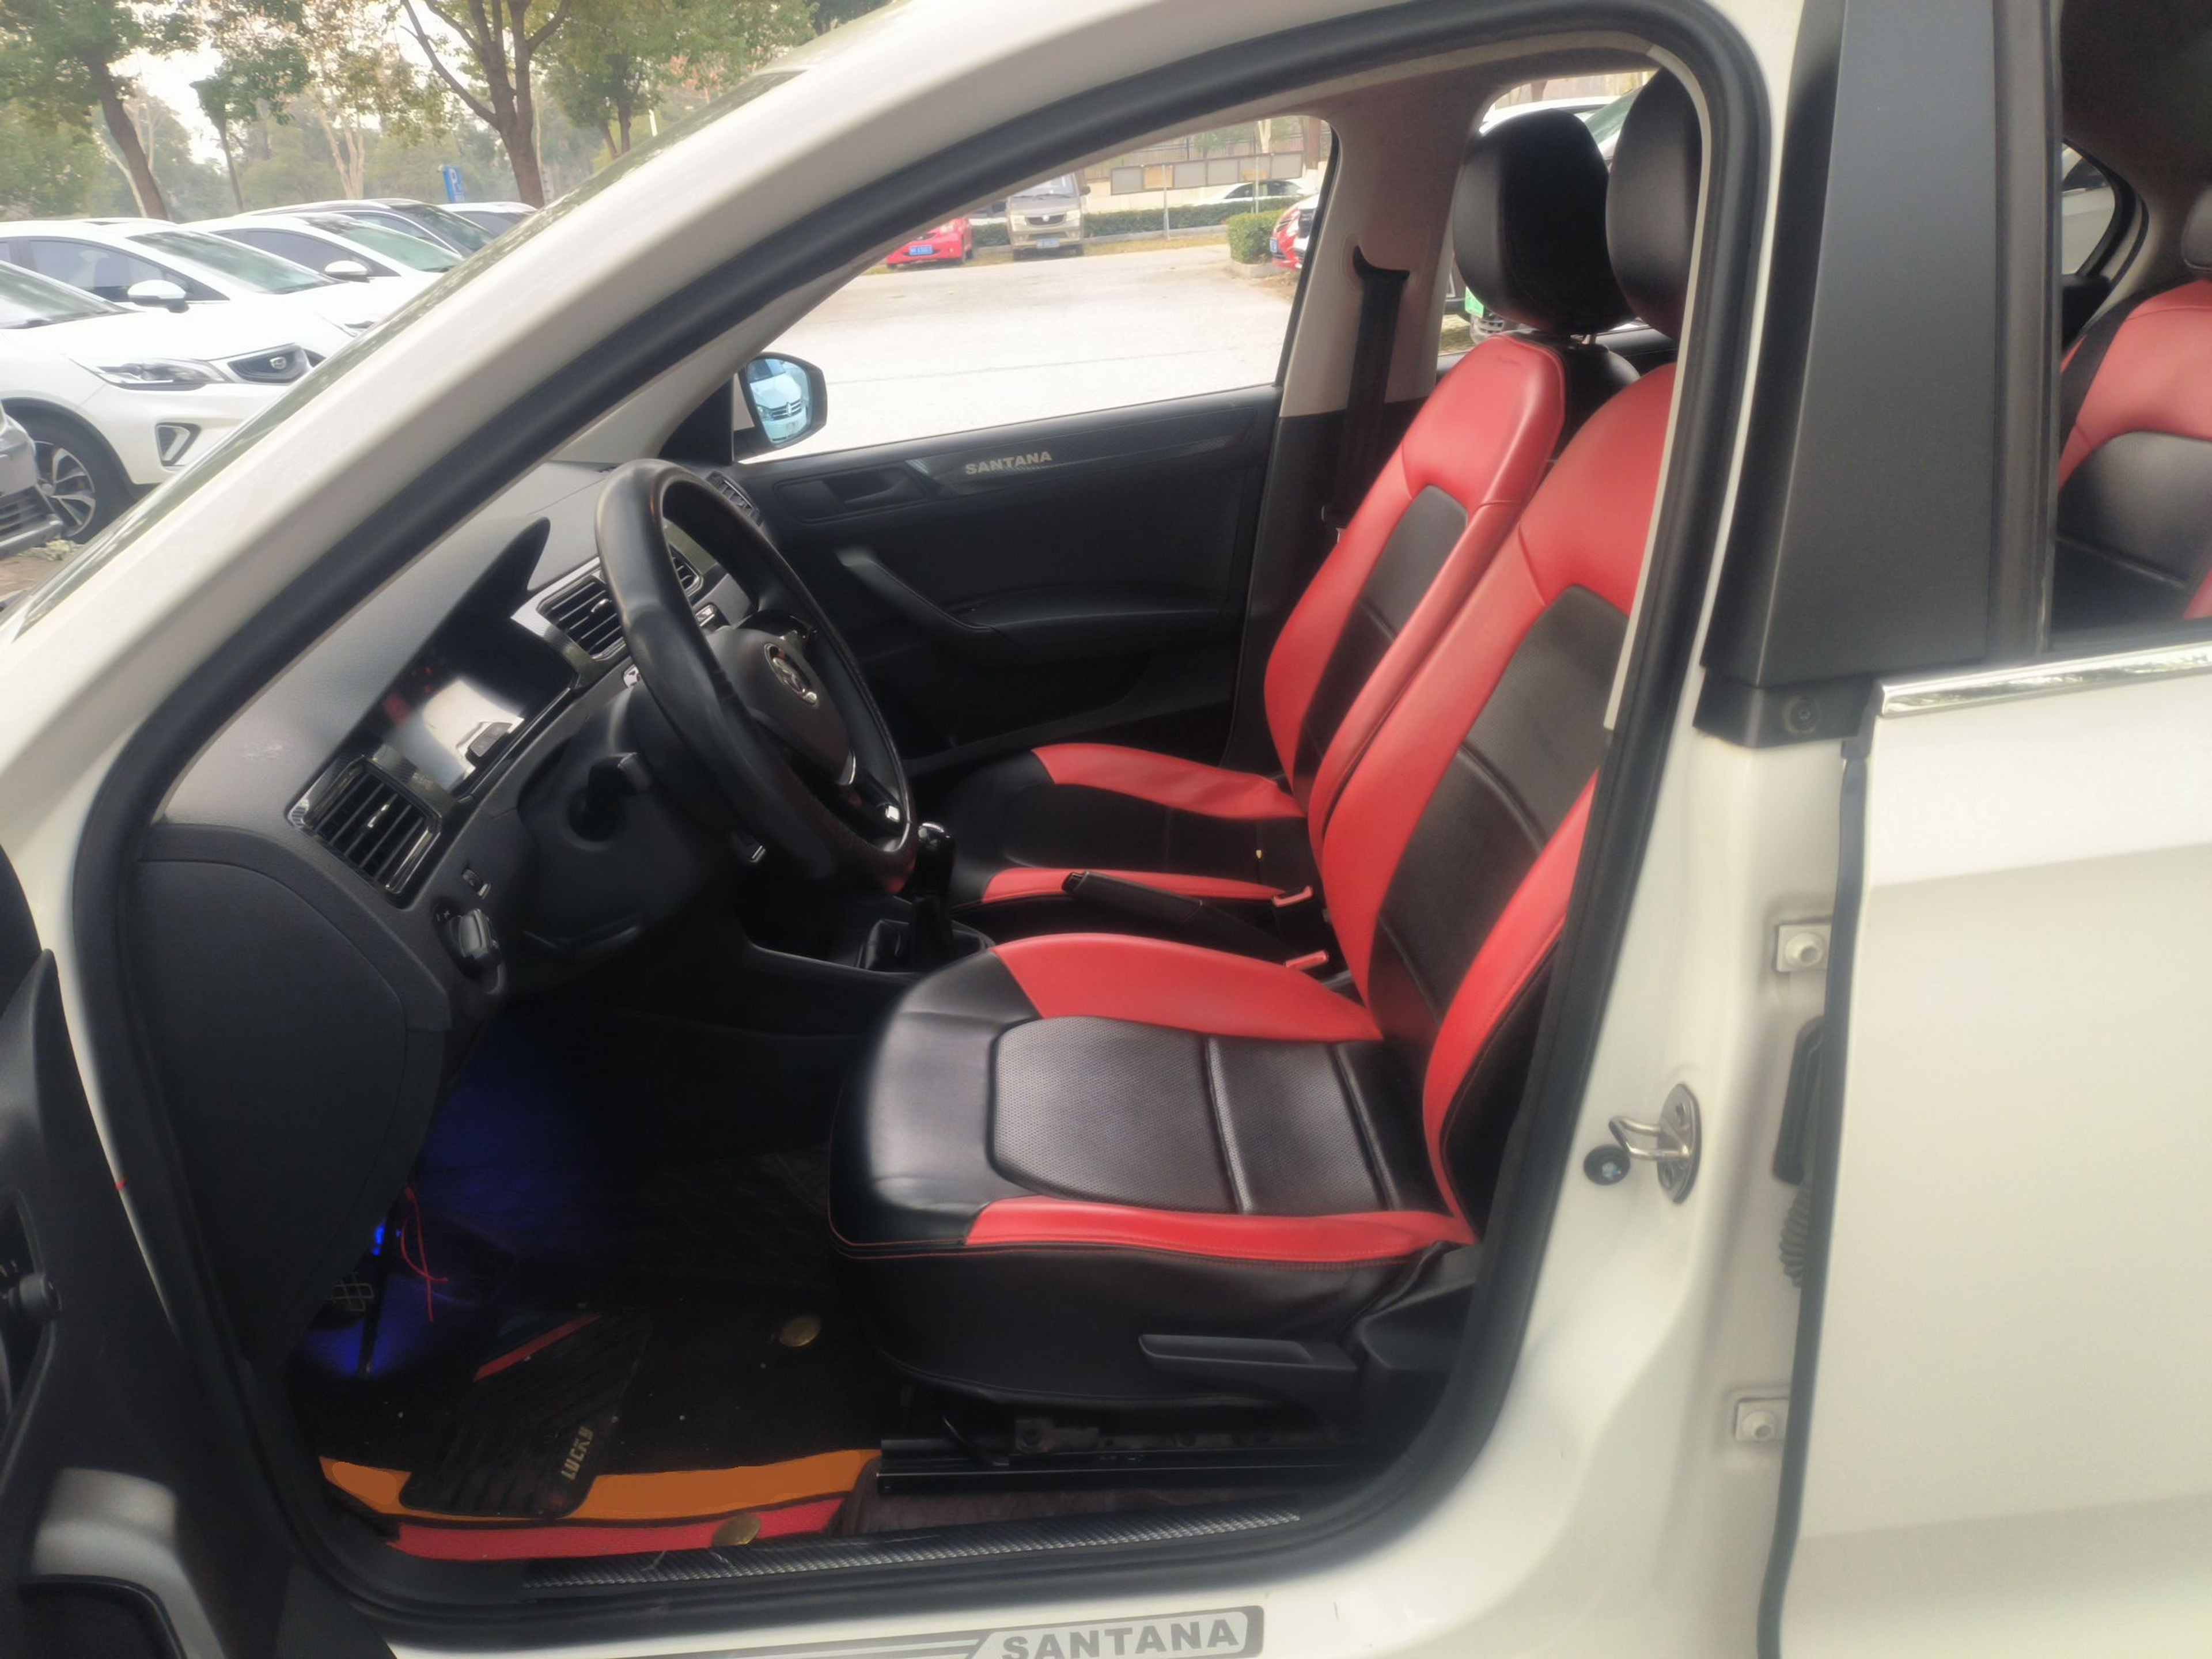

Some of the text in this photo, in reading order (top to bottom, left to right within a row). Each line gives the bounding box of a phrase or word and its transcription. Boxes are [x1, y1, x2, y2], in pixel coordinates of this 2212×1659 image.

[965, 451, 1052, 475] SANTANA
[560, 1426, 594, 1480] LUCKY
[1002, 1619, 1239, 1659] SANTANA
